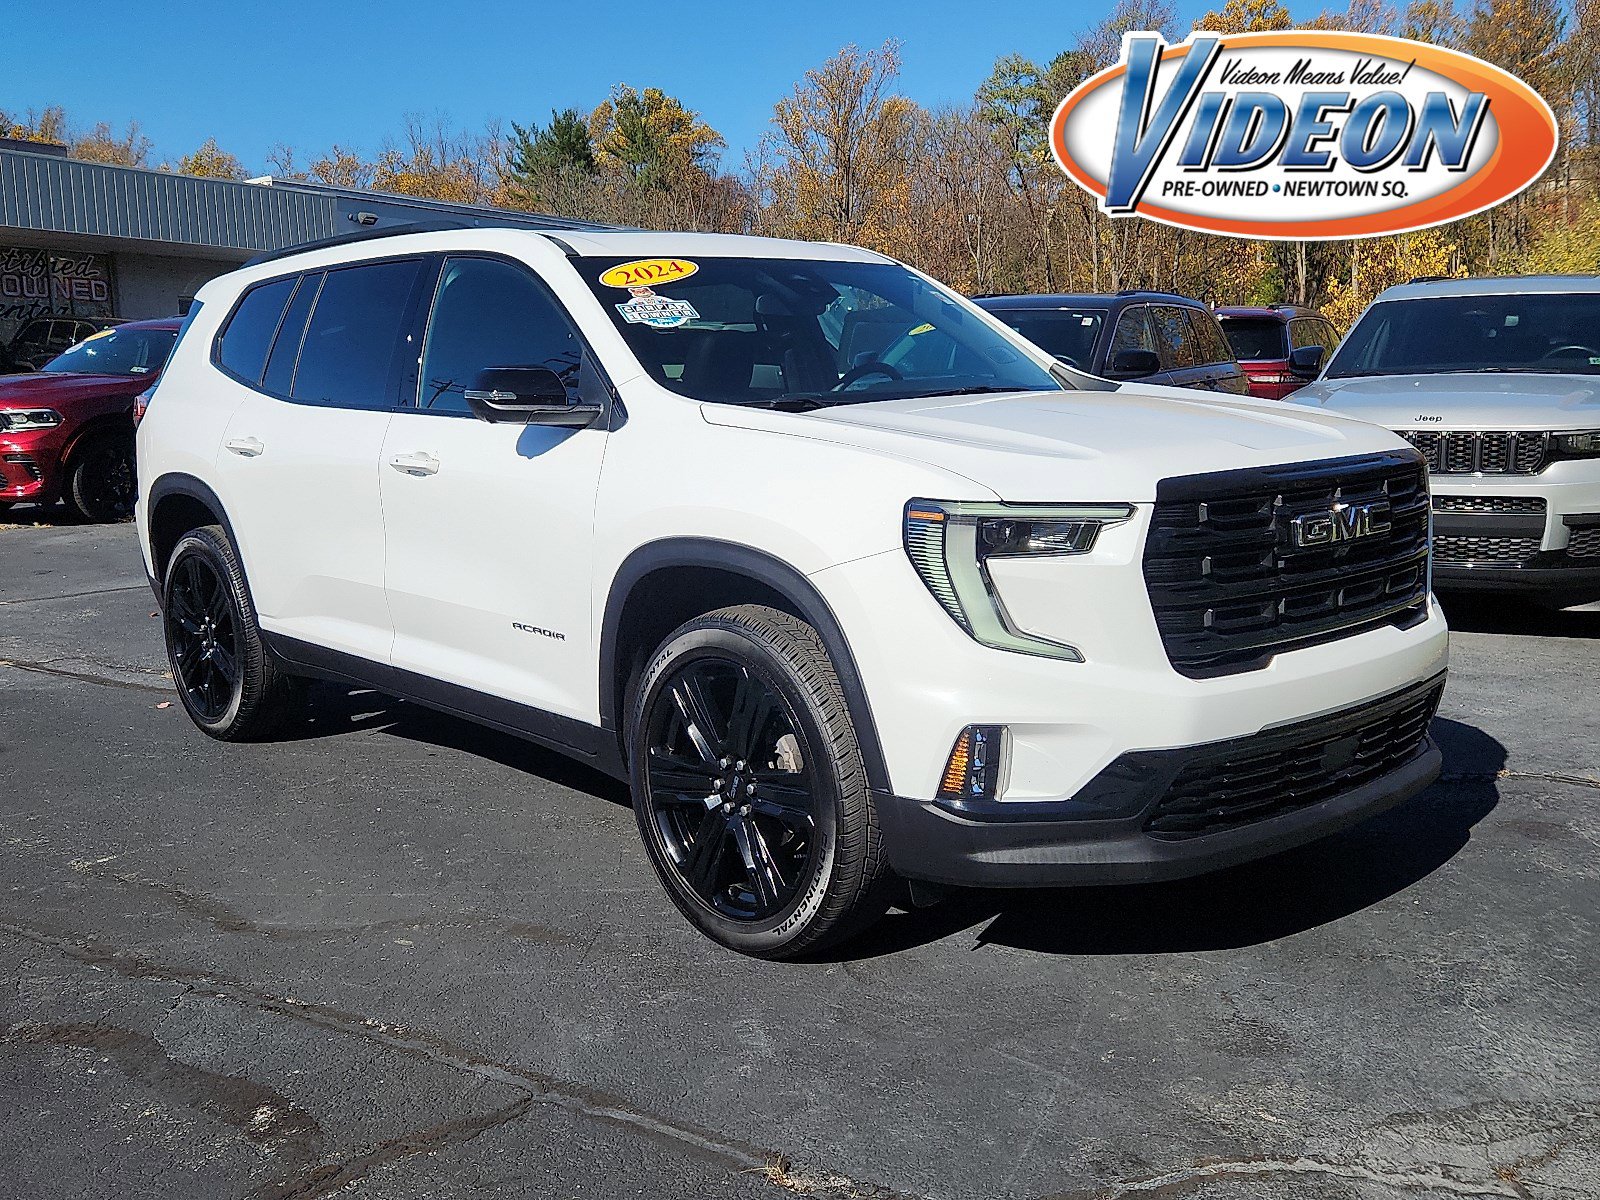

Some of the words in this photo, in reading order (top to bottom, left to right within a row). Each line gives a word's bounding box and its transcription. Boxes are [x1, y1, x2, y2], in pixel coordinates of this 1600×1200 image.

[615, 261, 685, 285] 2024
[1414, 414, 1443, 423] Jeep
[1290, 501, 1392, 547] GMC
[512, 622, 566, 641] ACADIA
